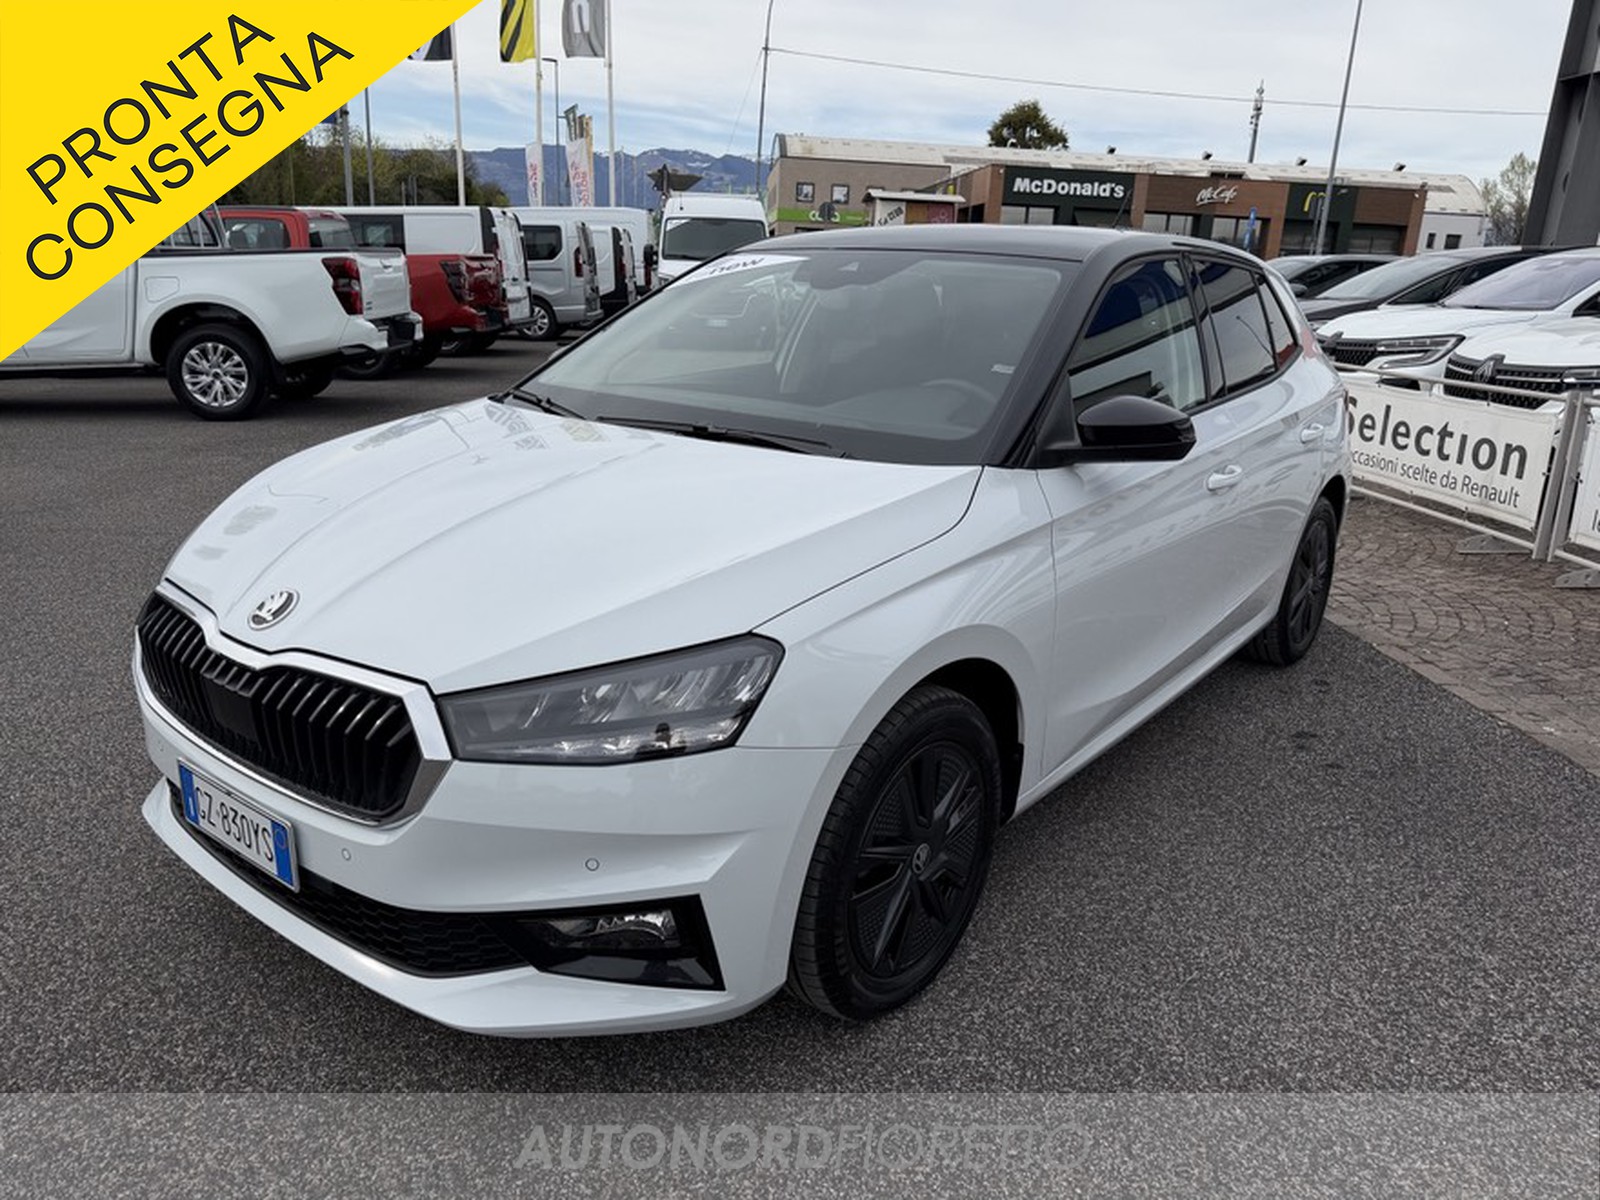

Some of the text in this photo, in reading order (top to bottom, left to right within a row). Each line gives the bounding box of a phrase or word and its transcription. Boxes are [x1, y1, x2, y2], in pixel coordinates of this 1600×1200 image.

[1012, 177, 1125, 198] McDonald's
[1352, 449, 1520, 508] ccasioni scelte da Renault
[219, 801, 275, 862] 830YS
